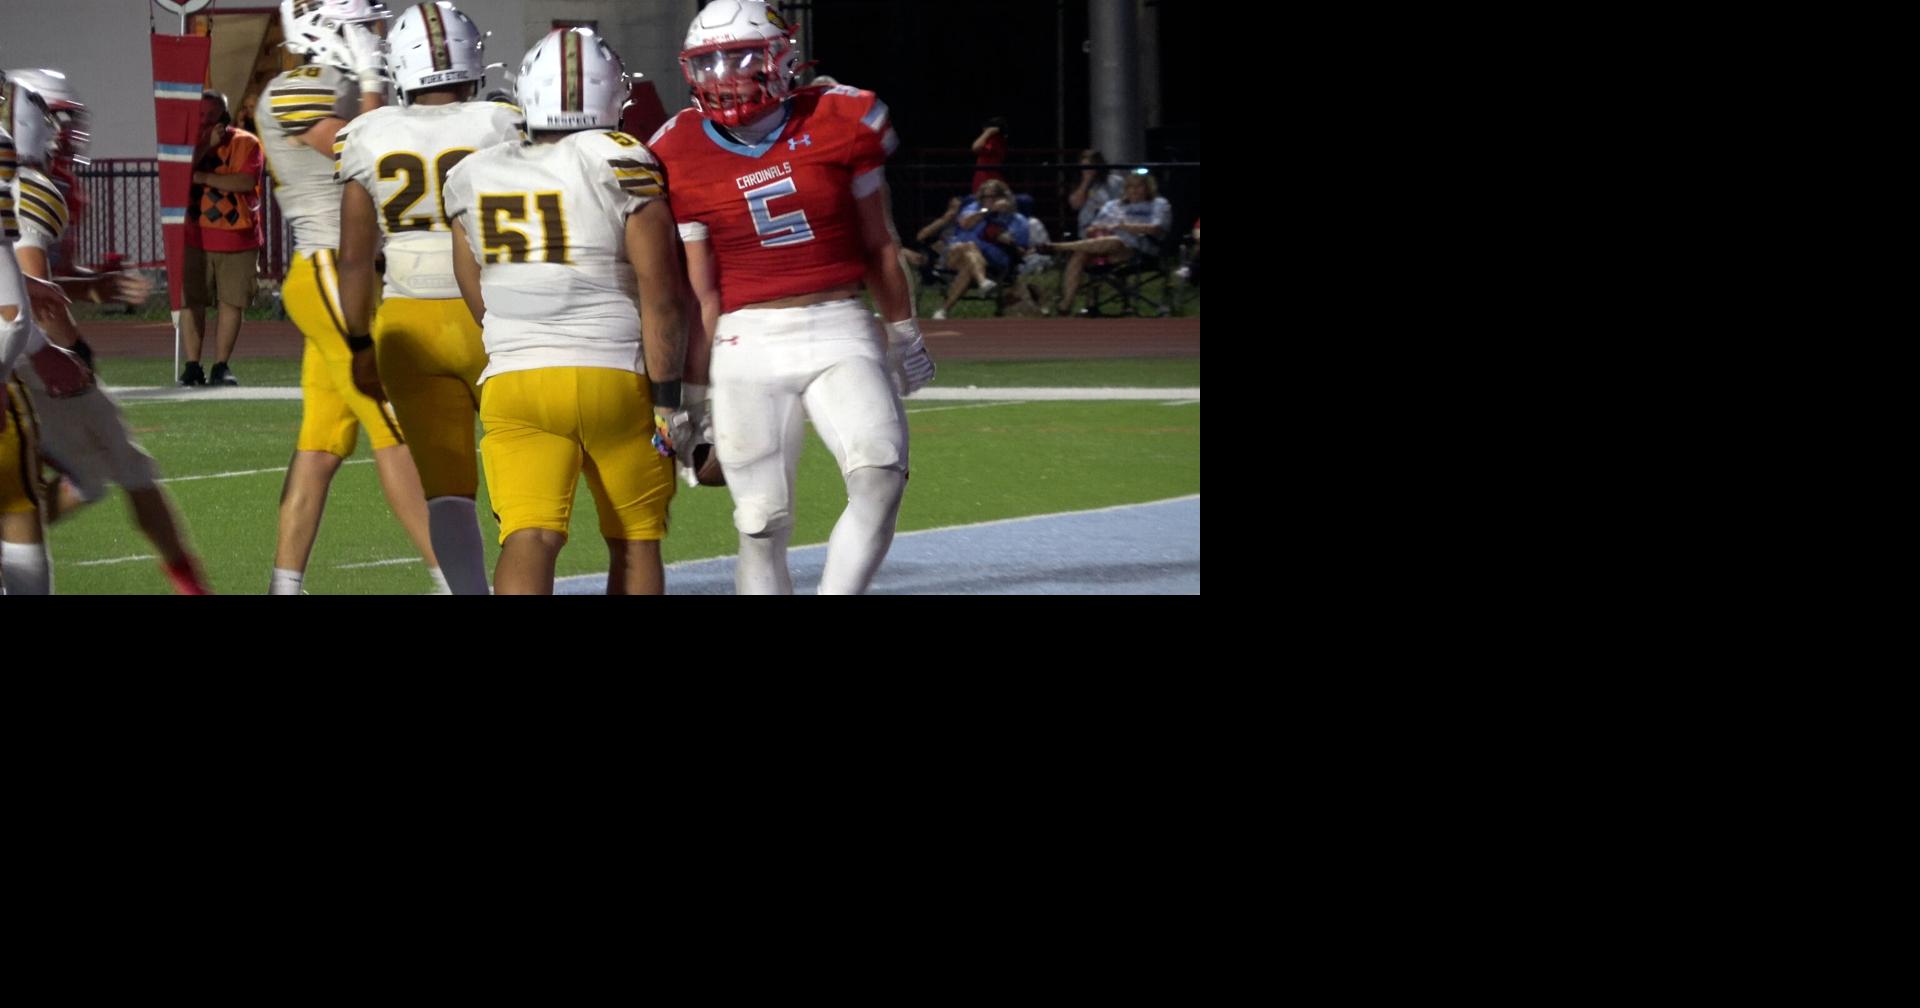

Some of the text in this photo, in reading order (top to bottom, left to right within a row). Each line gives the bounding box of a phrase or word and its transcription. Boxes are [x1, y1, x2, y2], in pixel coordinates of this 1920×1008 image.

[419, 70, 469, 85] WORK ETHIC
[546, 115, 598, 126] RESPECT
[735, 161, 792, 189] CARDINALS
[743, 176, 815, 247] 5
[478, 190, 570, 265] 51
